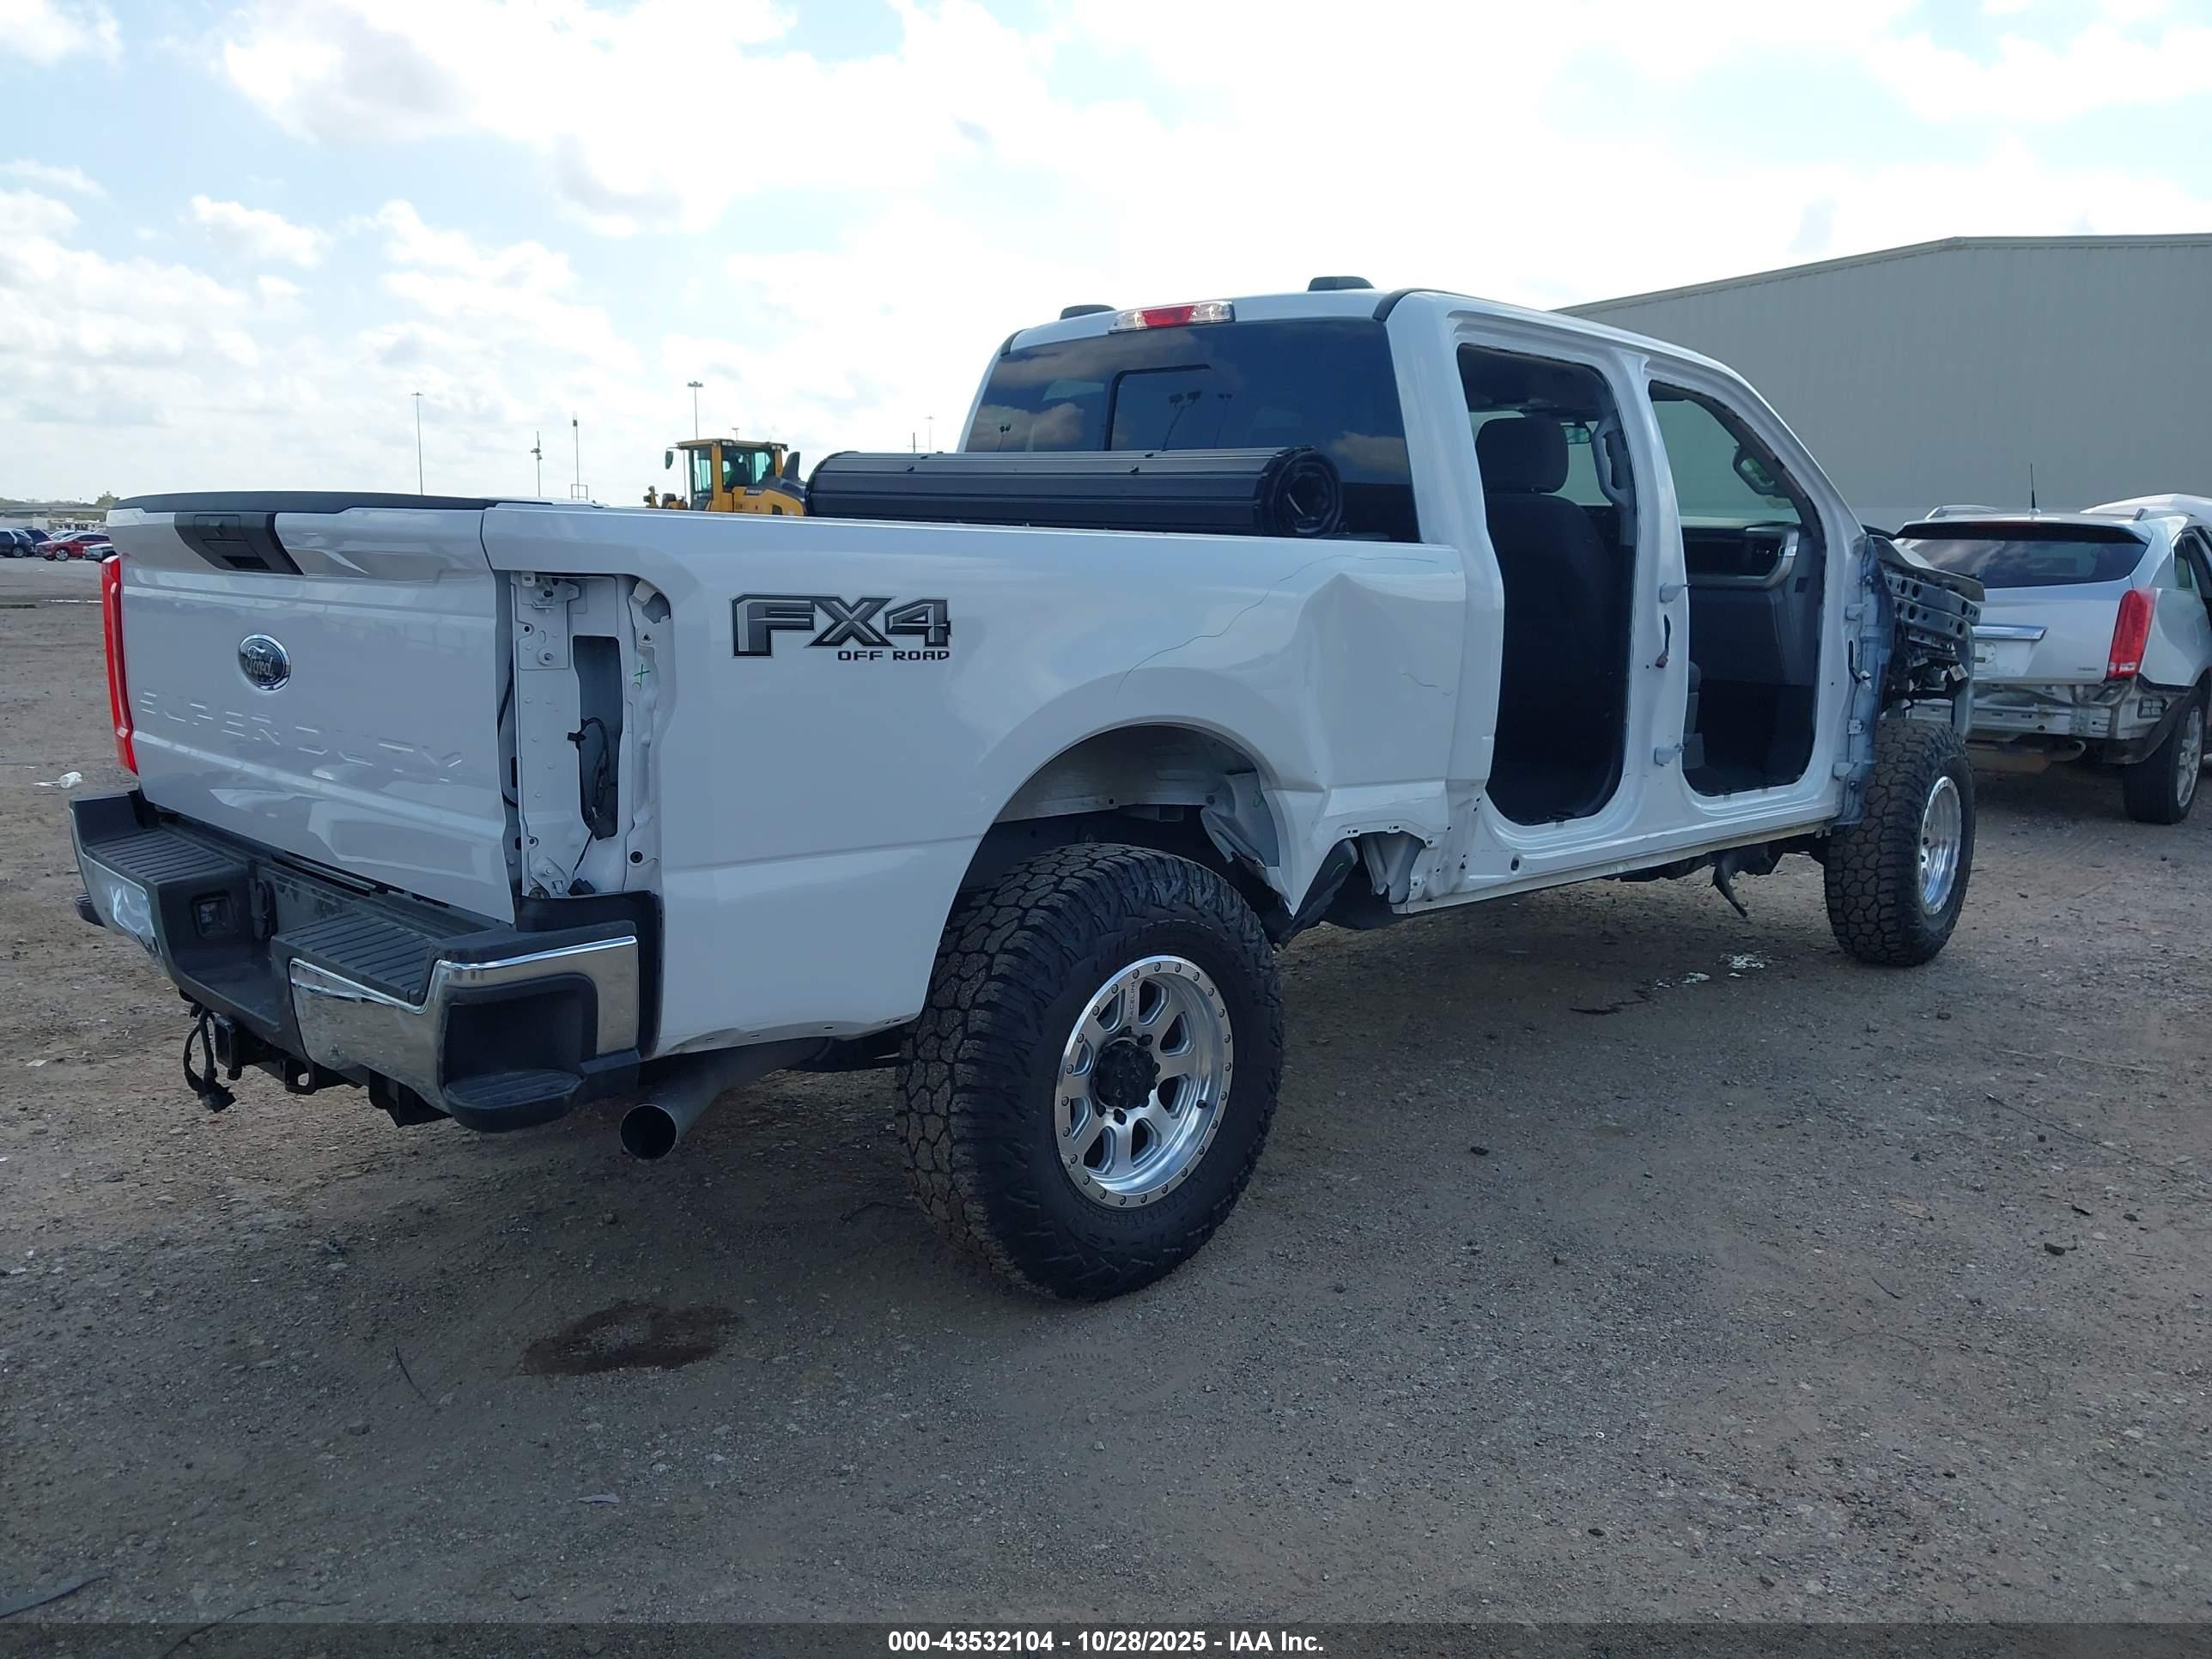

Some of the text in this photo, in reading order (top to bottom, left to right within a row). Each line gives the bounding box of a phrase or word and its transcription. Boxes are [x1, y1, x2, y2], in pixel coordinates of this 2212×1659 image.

[732, 592, 951, 657] FX4
[246, 645, 276, 681] Ford
[837, 650, 950, 661] OFF ROAD
[138, 690, 464, 782] SUPER DUTY
